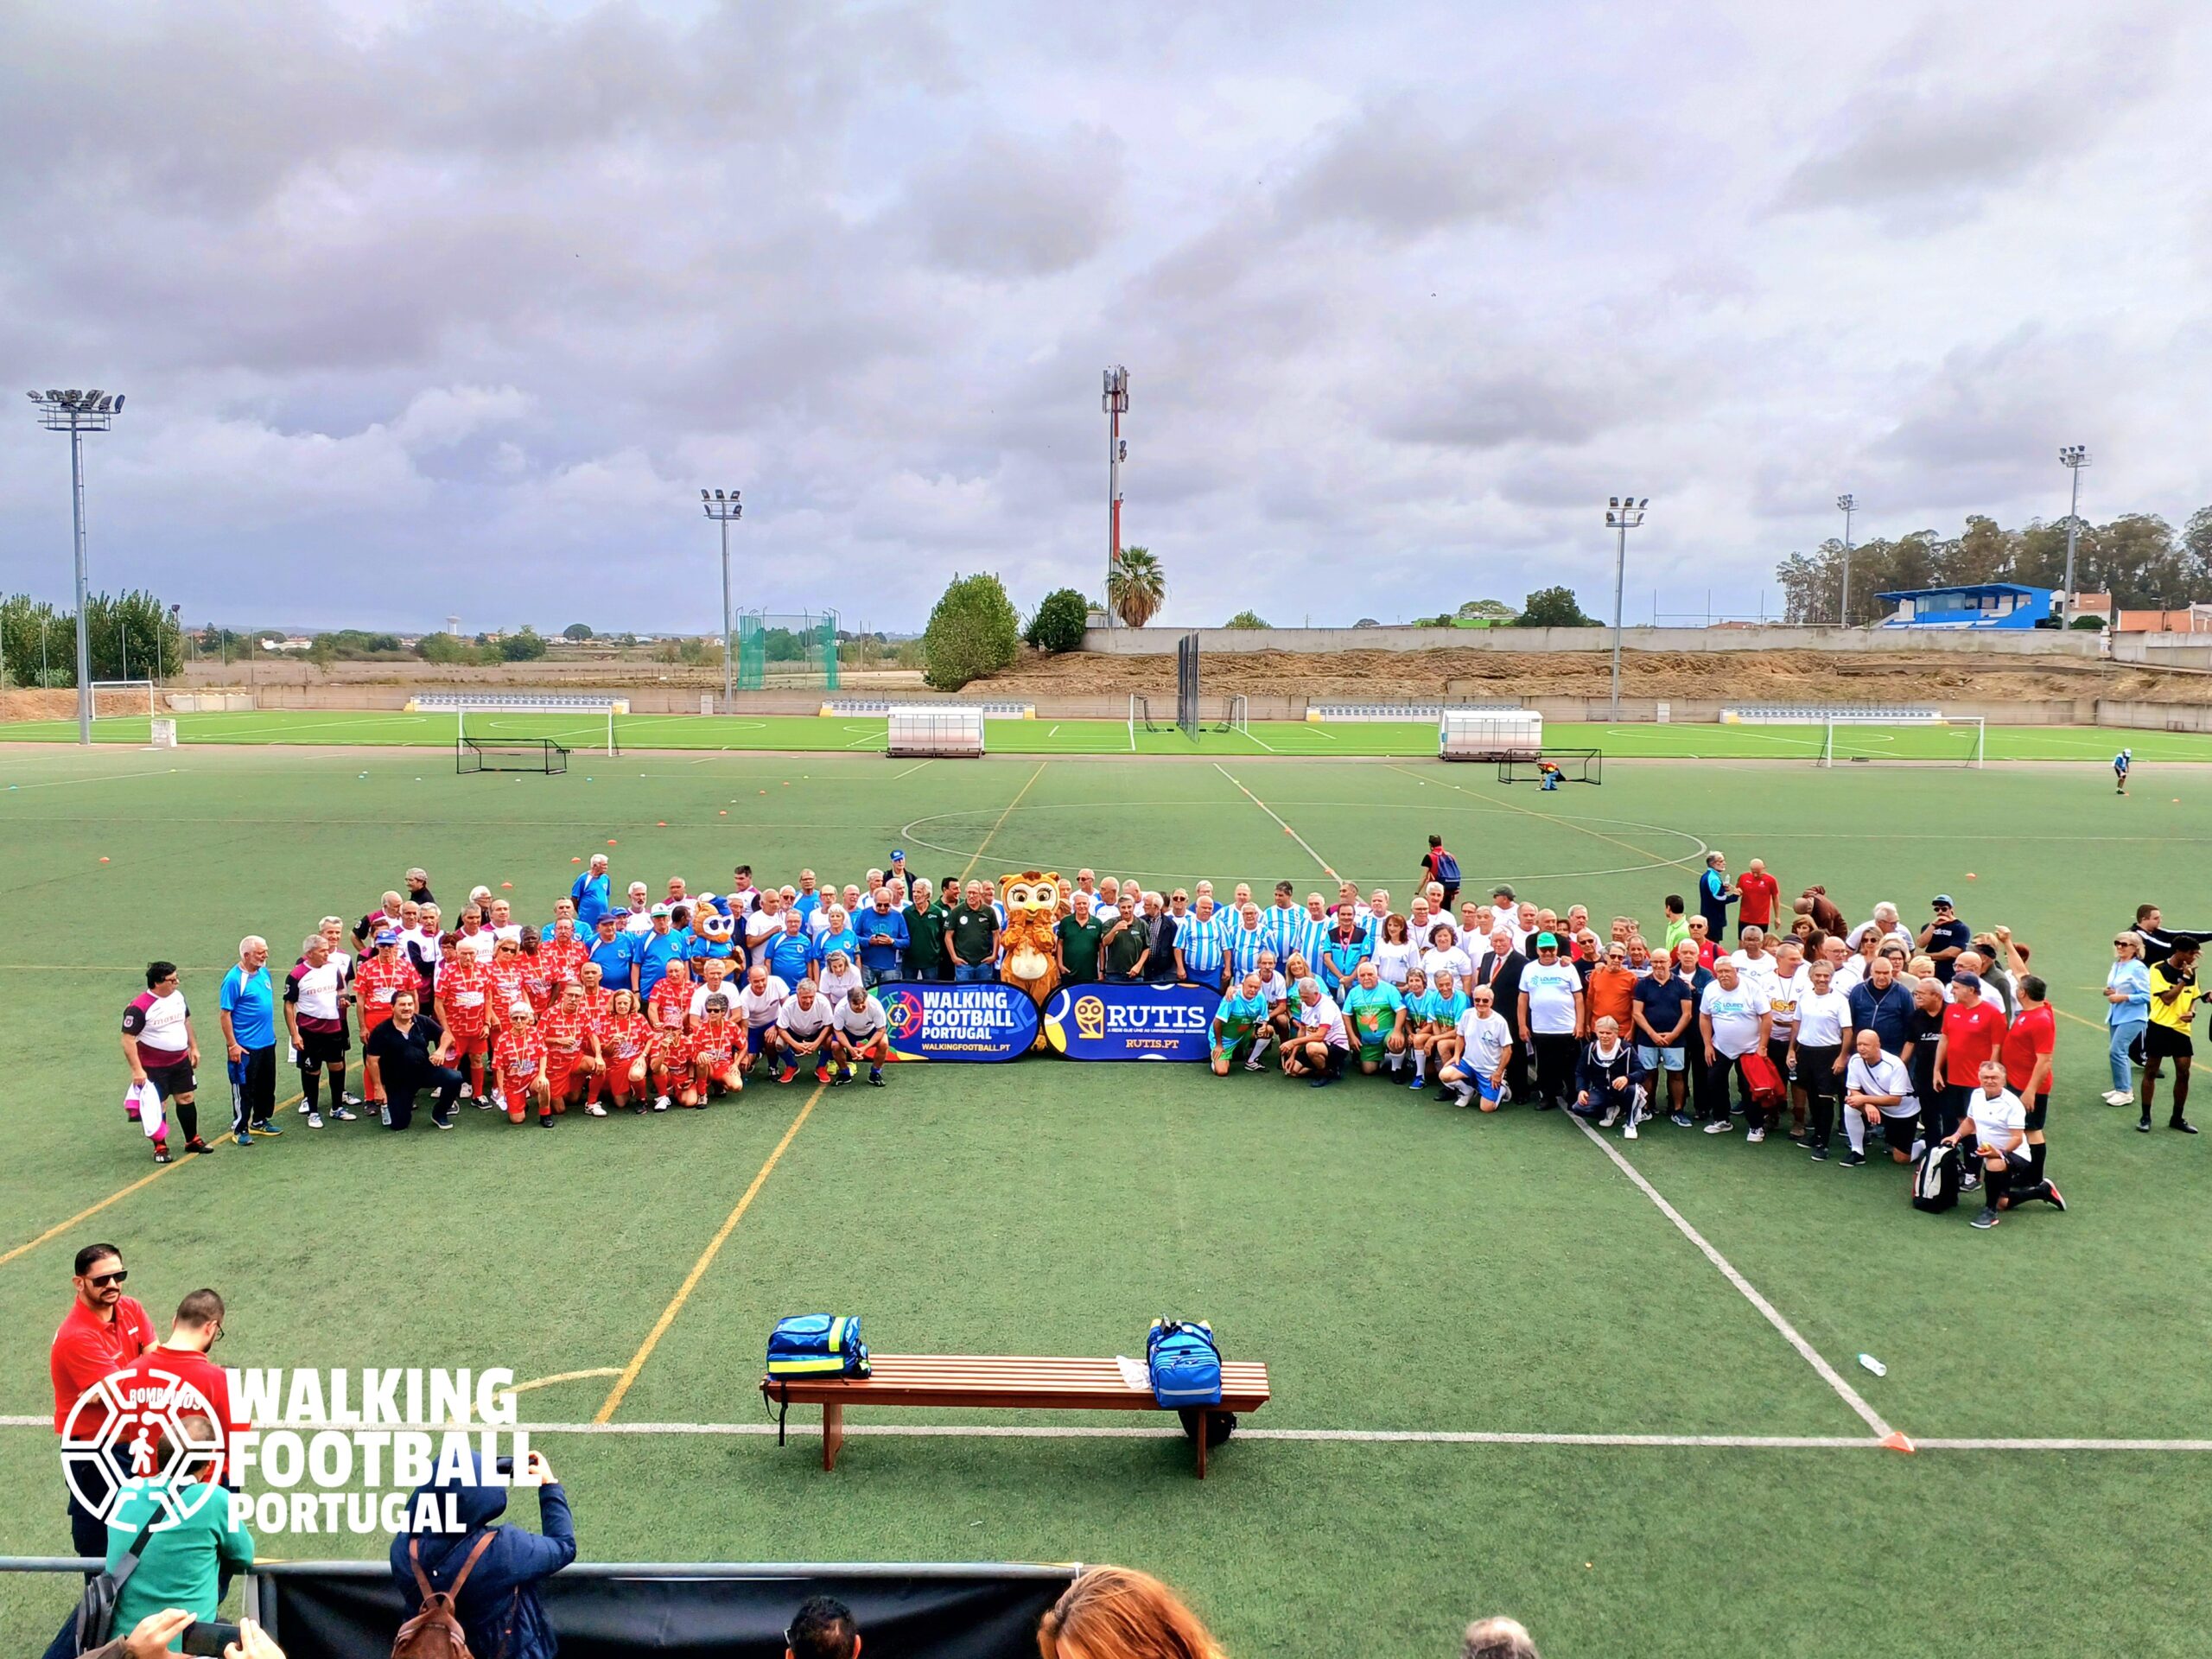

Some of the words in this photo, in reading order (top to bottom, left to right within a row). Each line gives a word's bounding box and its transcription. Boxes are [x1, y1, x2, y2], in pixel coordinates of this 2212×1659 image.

[922, 992, 1007, 1009] WALKING
[922, 1009, 1014, 1027] FOOTBALL
[1107, 1005, 1206, 1028] RUTIS
[922, 1027, 992, 1039] PORTUGAL
[922, 1043, 1011, 1052] WALKINGFOOTBALL.PT
[1126, 1039, 1179, 1049] RUTIS.PT
